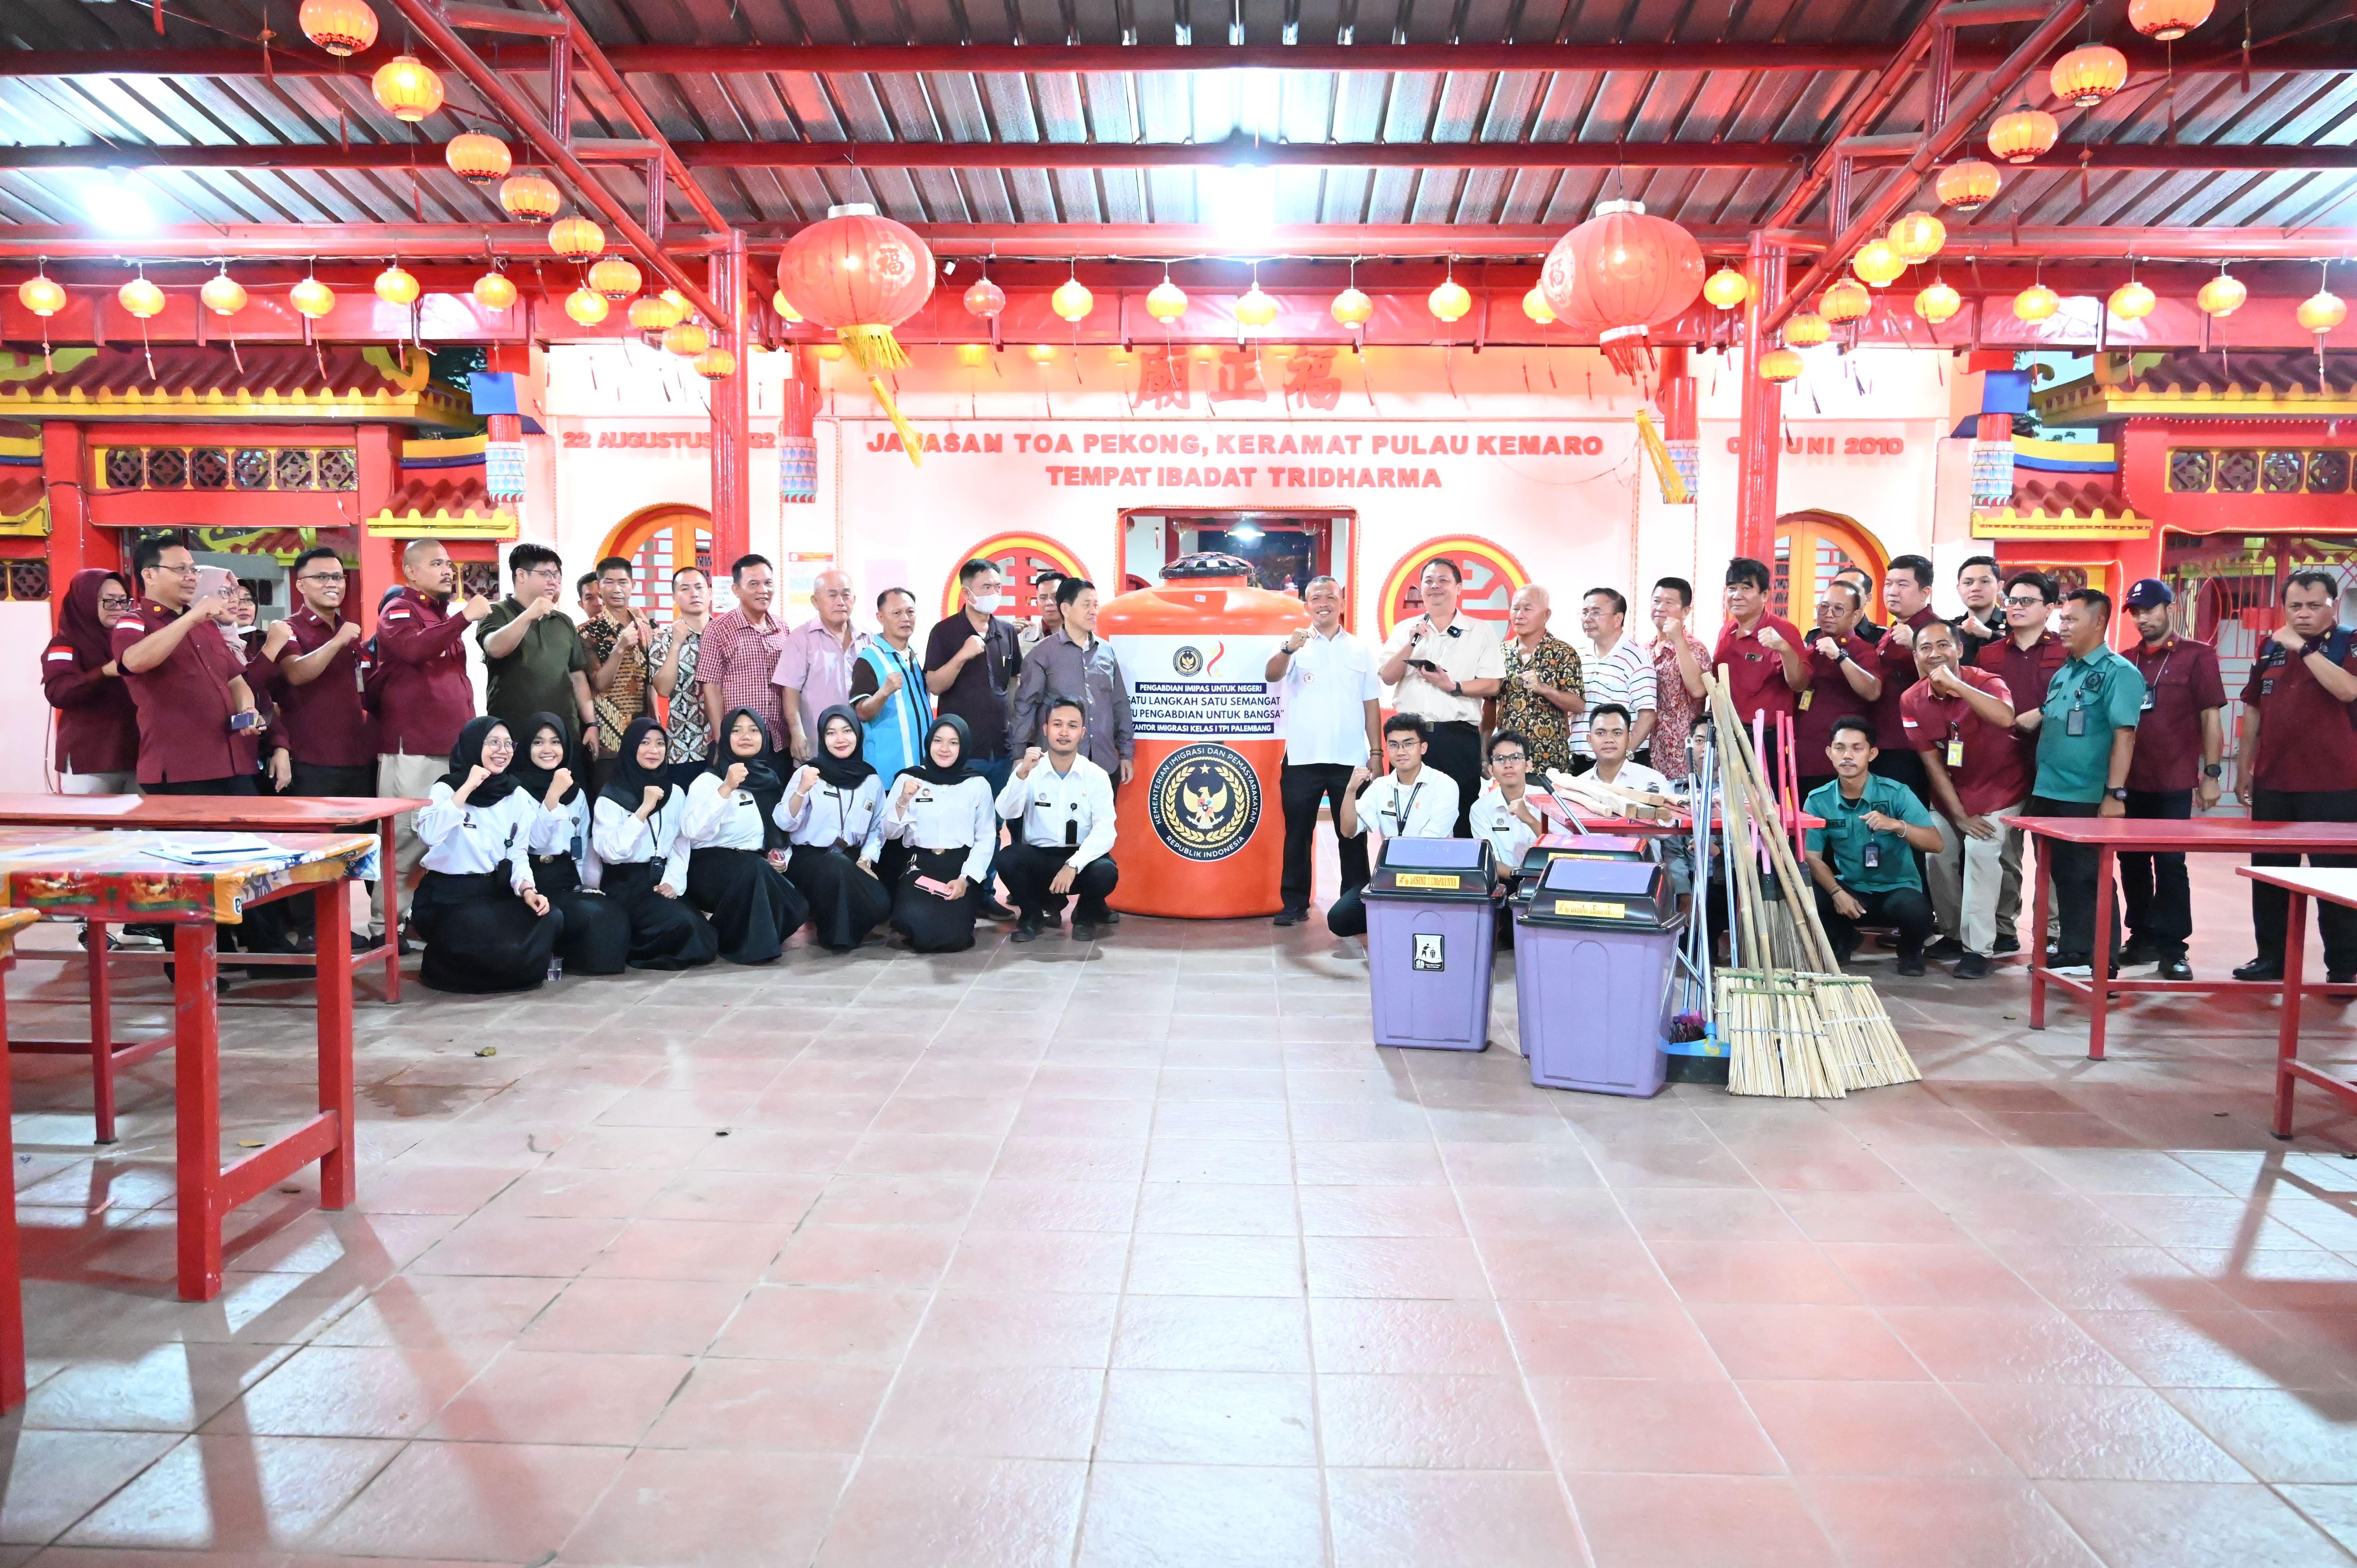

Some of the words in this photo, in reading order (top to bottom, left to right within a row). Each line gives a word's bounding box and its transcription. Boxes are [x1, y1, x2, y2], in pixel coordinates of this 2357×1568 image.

[563, 431, 591, 448] 22
[1014, 433, 1073, 453] TOA
[1083, 434, 1209, 457] PEKONG,
[1217, 434, 1362, 454] KERAMAT
[1372, 435, 1468, 454] PULAU
[1477, 435, 1604, 455] KEMARO
[1844, 437, 1904, 455] 2010
[1046, 466, 1152, 486] TEMPAT
[1157, 466, 1257, 487] IBADAT
[1268, 467, 1442, 488] TRIDHARMA
[1149, 696, 1198, 706] LANGKAH
[1201, 697, 1227, 706] SATU
[1230, 697, 1280, 706] SEMANGAT
[1140, 709, 1203, 719] PENGABDIAN
[1207, 710, 1240, 719] UNTUK
[1152, 765, 1170, 825] KEMENTERIAN
[1170, 747, 1205, 767] IMIGRASI
[1207, 748, 1226, 757] DAN
[1227, 754, 1259, 823] PEMASYARAKATAN
[1166, 835, 1201, 858] REPUBLIK
[1203, 836, 1245, 858] INDONESIA
[1410, 876, 1426, 885] DISINI
